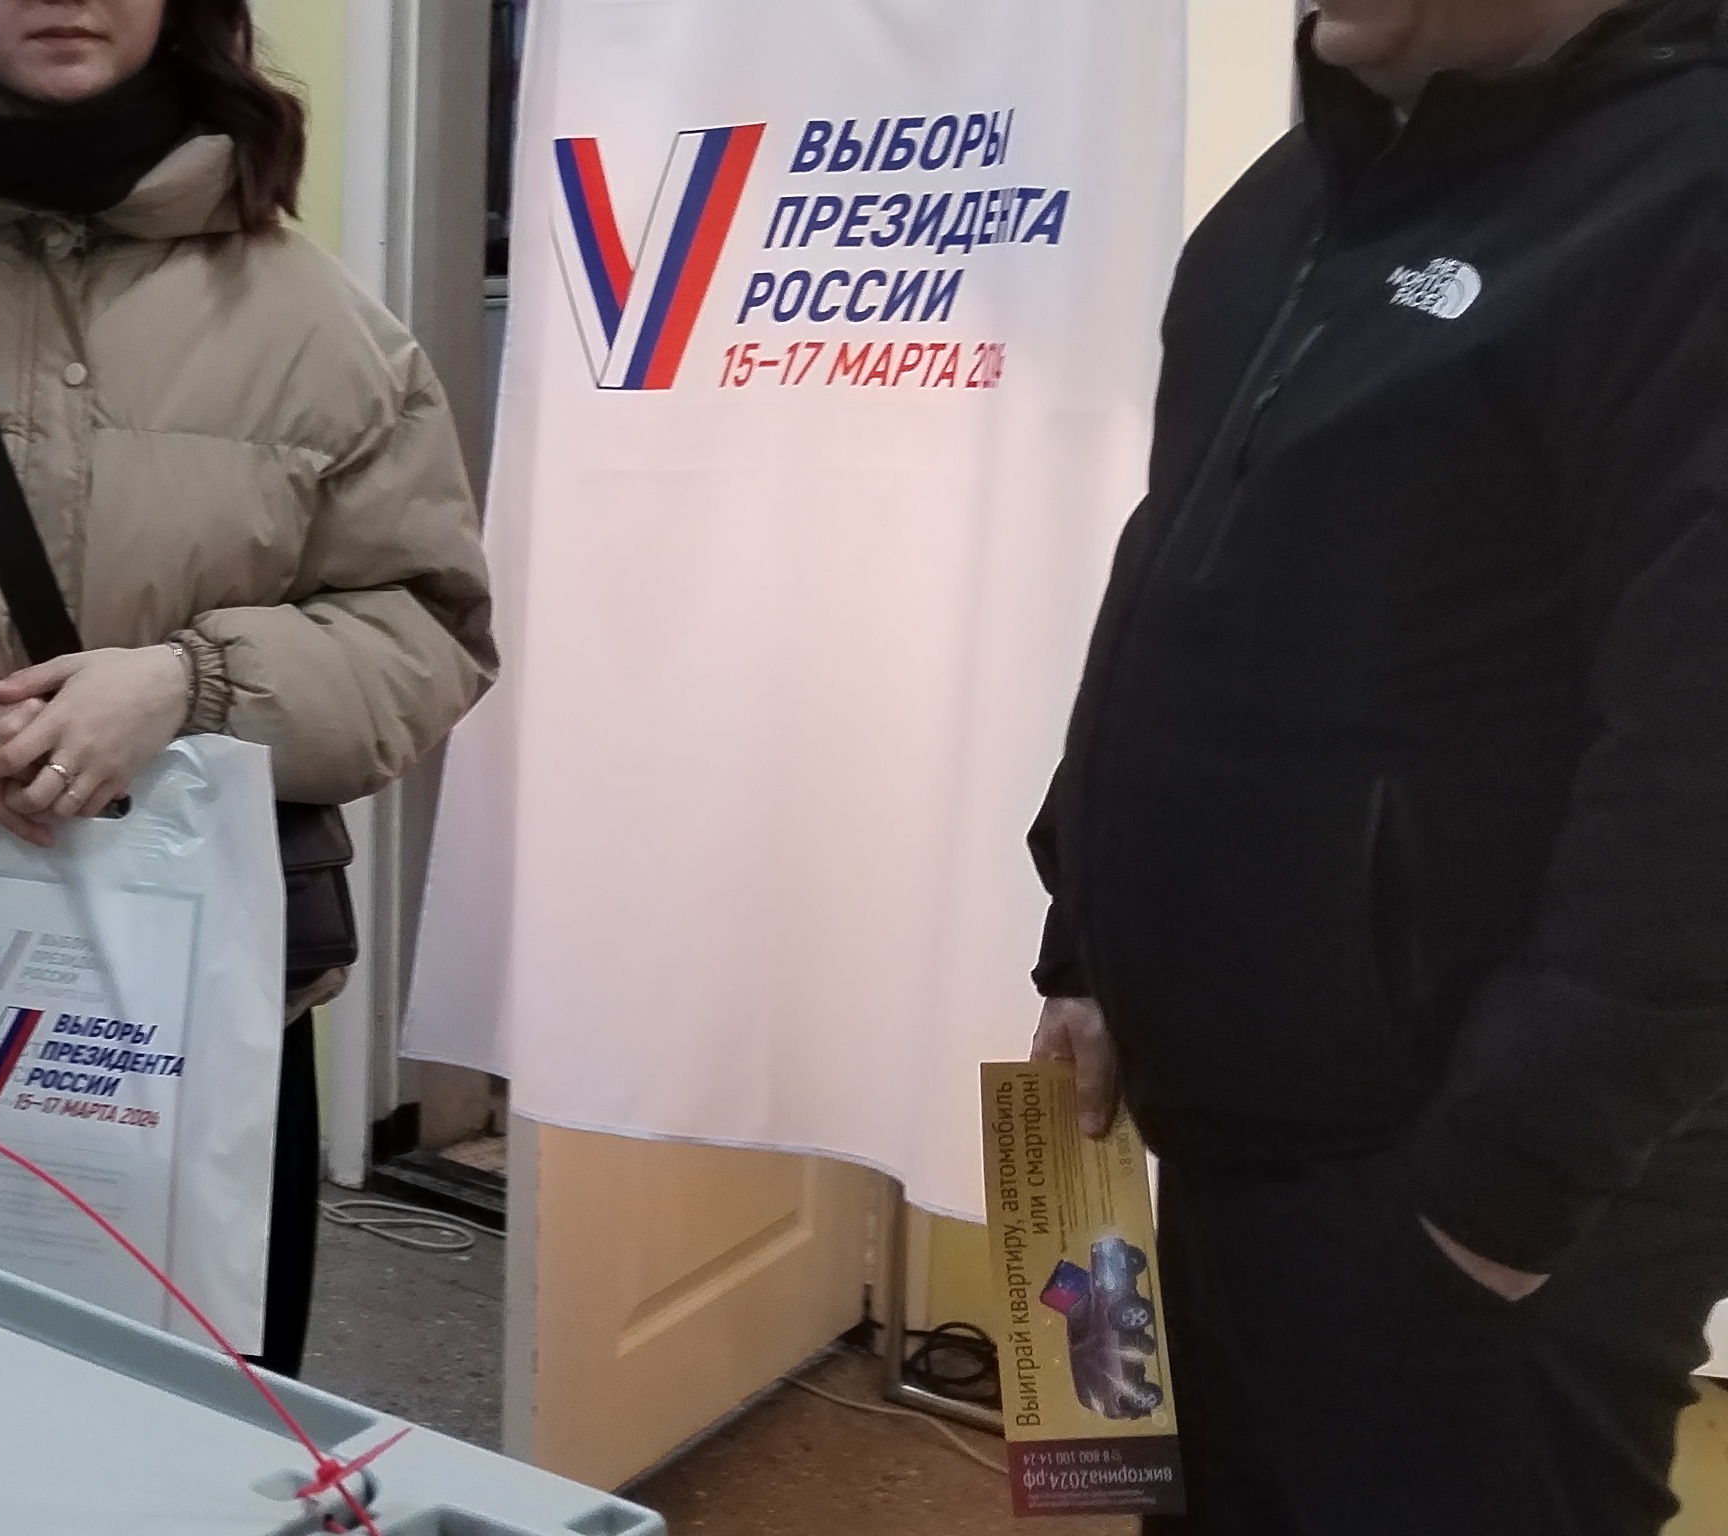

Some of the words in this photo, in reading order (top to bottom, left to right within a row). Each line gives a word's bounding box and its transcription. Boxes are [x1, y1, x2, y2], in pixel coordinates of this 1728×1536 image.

[789, 108, 1015, 173] ВЫБОРЫ
[736, 268, 964, 324] РОССИИ
[825, 341, 962, 388] МАРТА
[52, 1013, 159, 1046] ВЫБОРЫ
[38, 1040, 186, 1078] ПРЕЗИДЕНТА
[25, 1068, 123, 1098] РОССИИ
[60, 1098, 119, 1124] МАРТА
[118, 1106, 162, 1129] 2024
[1017, 1072, 1048, 1188] смартфон!
[992, 1081, 1020, 1212] автомобиль
[1030, 1195, 1050, 1235] или
[1003, 1219, 1033, 1325] квартиру,
[1008, 1330, 1041, 1427] Выиграй
[1023, 1465, 1172, 1490] викторина2024.рф
